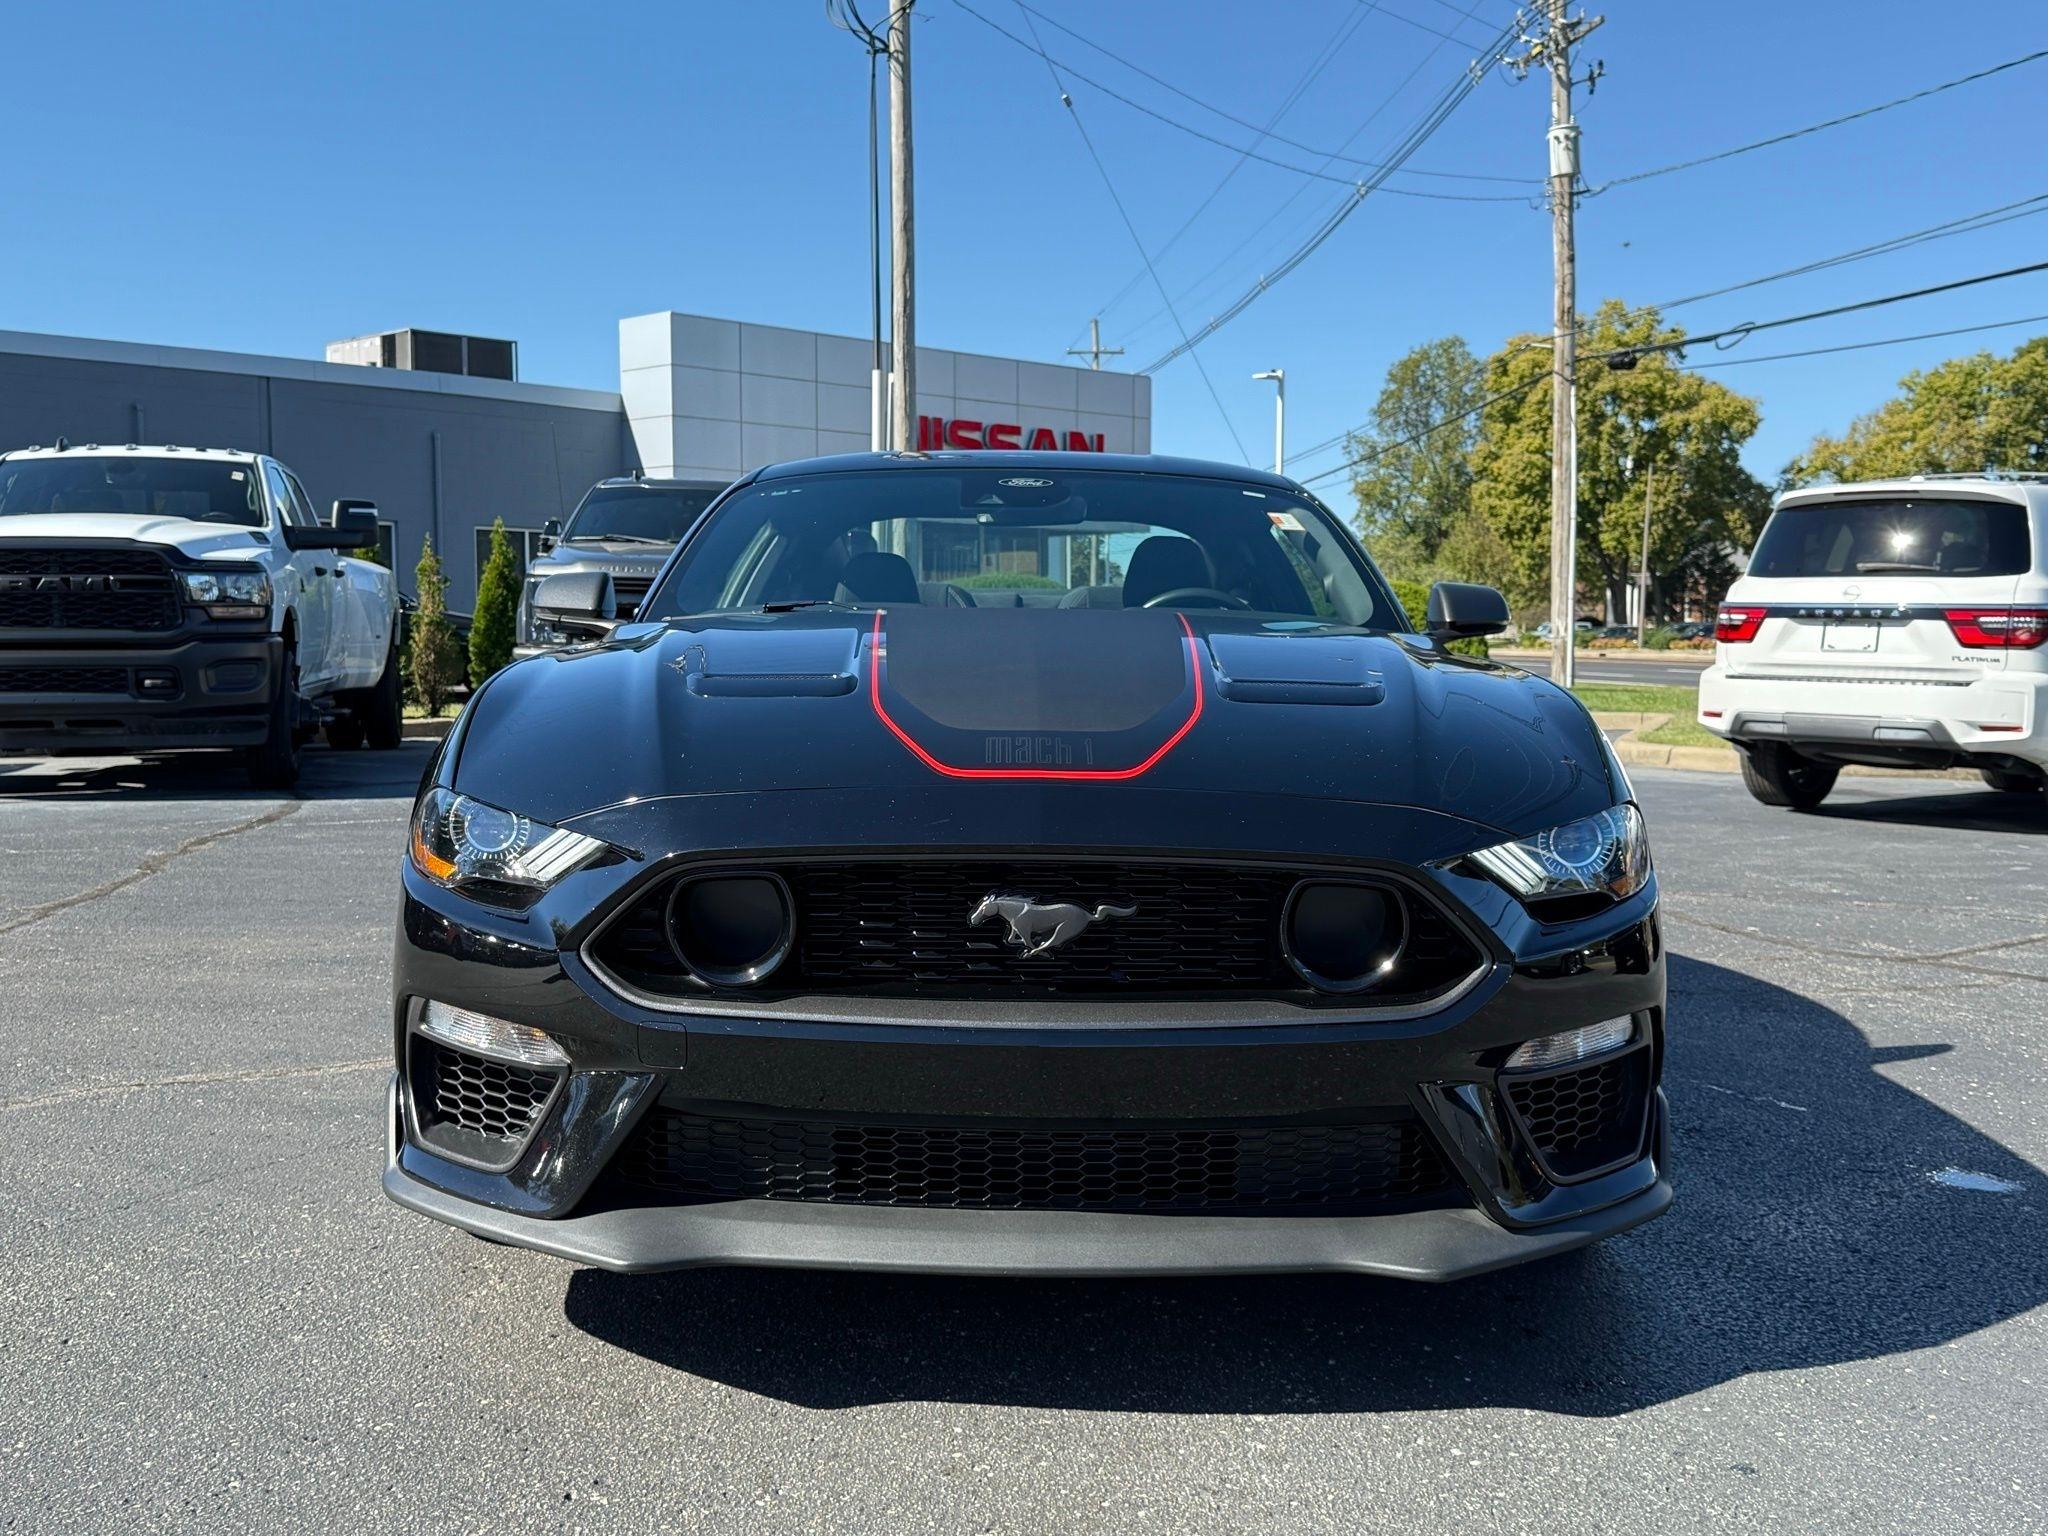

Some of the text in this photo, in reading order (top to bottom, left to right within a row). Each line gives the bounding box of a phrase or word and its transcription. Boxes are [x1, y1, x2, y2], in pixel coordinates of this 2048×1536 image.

[0, 574, 105, 593] RAM
[1951, 655, 2001, 663] PLATINUM
[1084, 738, 1093, 765] 1
